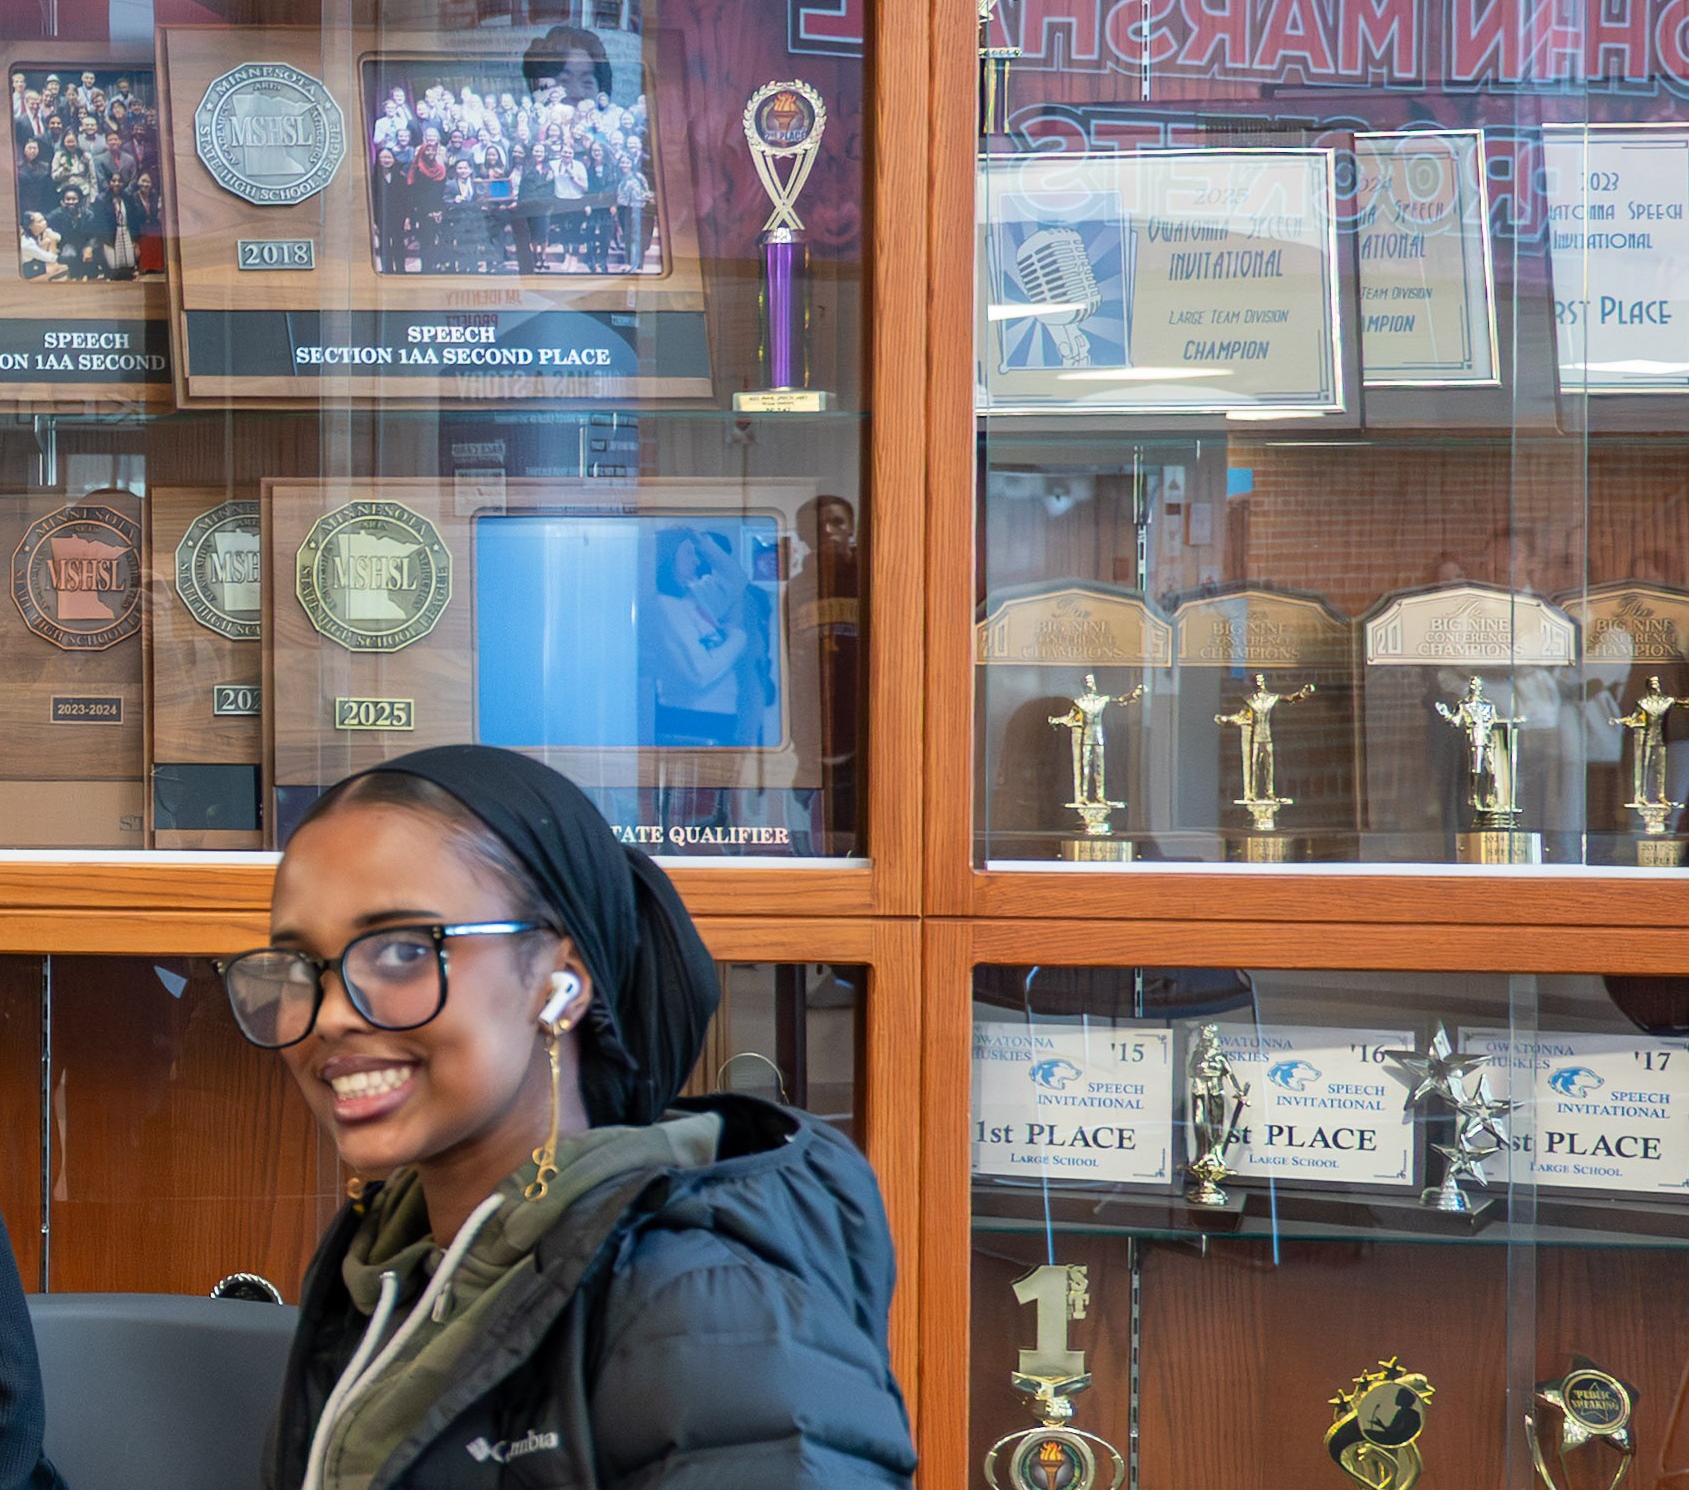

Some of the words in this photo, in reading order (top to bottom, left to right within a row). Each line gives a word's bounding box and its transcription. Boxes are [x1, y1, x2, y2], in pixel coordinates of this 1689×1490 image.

[215, 67, 316, 97] MINNESOTA
[230, 115, 313, 147] MSHSL
[199, 126, 223, 170] STATE
[220, 170, 256, 198] HIGH
[259, 179, 320, 200] SCHOOL
[320, 123, 341, 179] LEAGUE
[1393, 200, 1444, 224] SPEECH
[1549, 204, 1615, 220] ATONNA
[1628, 201, 1683, 220] SPEECH
[1361, 233, 1426, 260] ATIONAL
[1553, 230, 1653, 249] INVITATIONAL
[244, 243, 308, 265] 2018
[1169, 250, 1283, 281] INVITATIONAL
[1361, 287, 1388, 300] TEAM
[1392, 287, 1433, 300] DIVISION
[1169, 310, 1205, 325] LARGE
[1211, 309, 1240, 324] TEAM
[1244, 309, 1290, 323] DIVISION
[1600, 296, 1672, 326] PLACE
[44, 332, 130, 350] SPEECH
[407, 326, 495, 344] SPEECH
[296, 347, 392, 365] SECTION
[398, 347, 439, 365] 1AA
[443, 347, 533, 366] SECOND
[538, 348, 611, 366] PLACE
[1183, 340, 1269, 360] CHAMPION
[35, 354, 73, 371] 1AA
[78, 354, 166, 371] SECOND
[321, 504, 427, 536] MINNESOTA
[46, 559, 124, 592] MSHSL
[210, 552, 261, 583] MSH
[333, 556, 417, 591] MSHSL
[1430, 619, 1464, 631] BIG
[1468, 619, 1509, 631] NINE
[1594, 619, 1628, 632] BIG
[1425, 631, 1513, 643] CONFERENCE
[1416, 643, 1523, 657] CHAMPIONS
[221, 689, 261, 710] 202
[57, 703, 118, 716] 2023-2024
[343, 701, 407, 725] 2025
[610, 826, 664, 843] TATE
[669, 826, 790, 847] QUALIFIER
[1219, 1035, 1294, 1050] WATONNA
[1486, 1041, 1575, 1057] OWATONNA
[1111, 1042, 1145, 1063] '15
[1351, 1044, 1386, 1063] '16
[1634, 1051, 1672, 1071] '17
[1088, 1082, 1144, 1095] SPEECH
[1328, 1084, 1385, 1097] SPEECH
[1610, 1091, 1670, 1104] SPEECH
[1038, 1094, 1144, 1109] INVITATIONAL
[1276, 1095, 1385, 1111] INVITATIONAL
[1557, 1102, 1671, 1119] INVITATIONAL
[976, 1121, 1014, 1144] 1st
[1025, 1123, 1136, 1150] PLACE
[1227, 1125, 1252, 1145] st
[1264, 1124, 1377, 1151] PLACE
[1545, 1131, 1663, 1160] PLACE
[1011, 1153, 1049, 1165] LARGE
[1052, 1155, 1099, 1167] SCHOOL
[1249, 1154, 1287, 1166] LARGE
[1292, 1155, 1339, 1168] SCHOOL
[1573, 1164, 1623, 1177] SCHOOL
